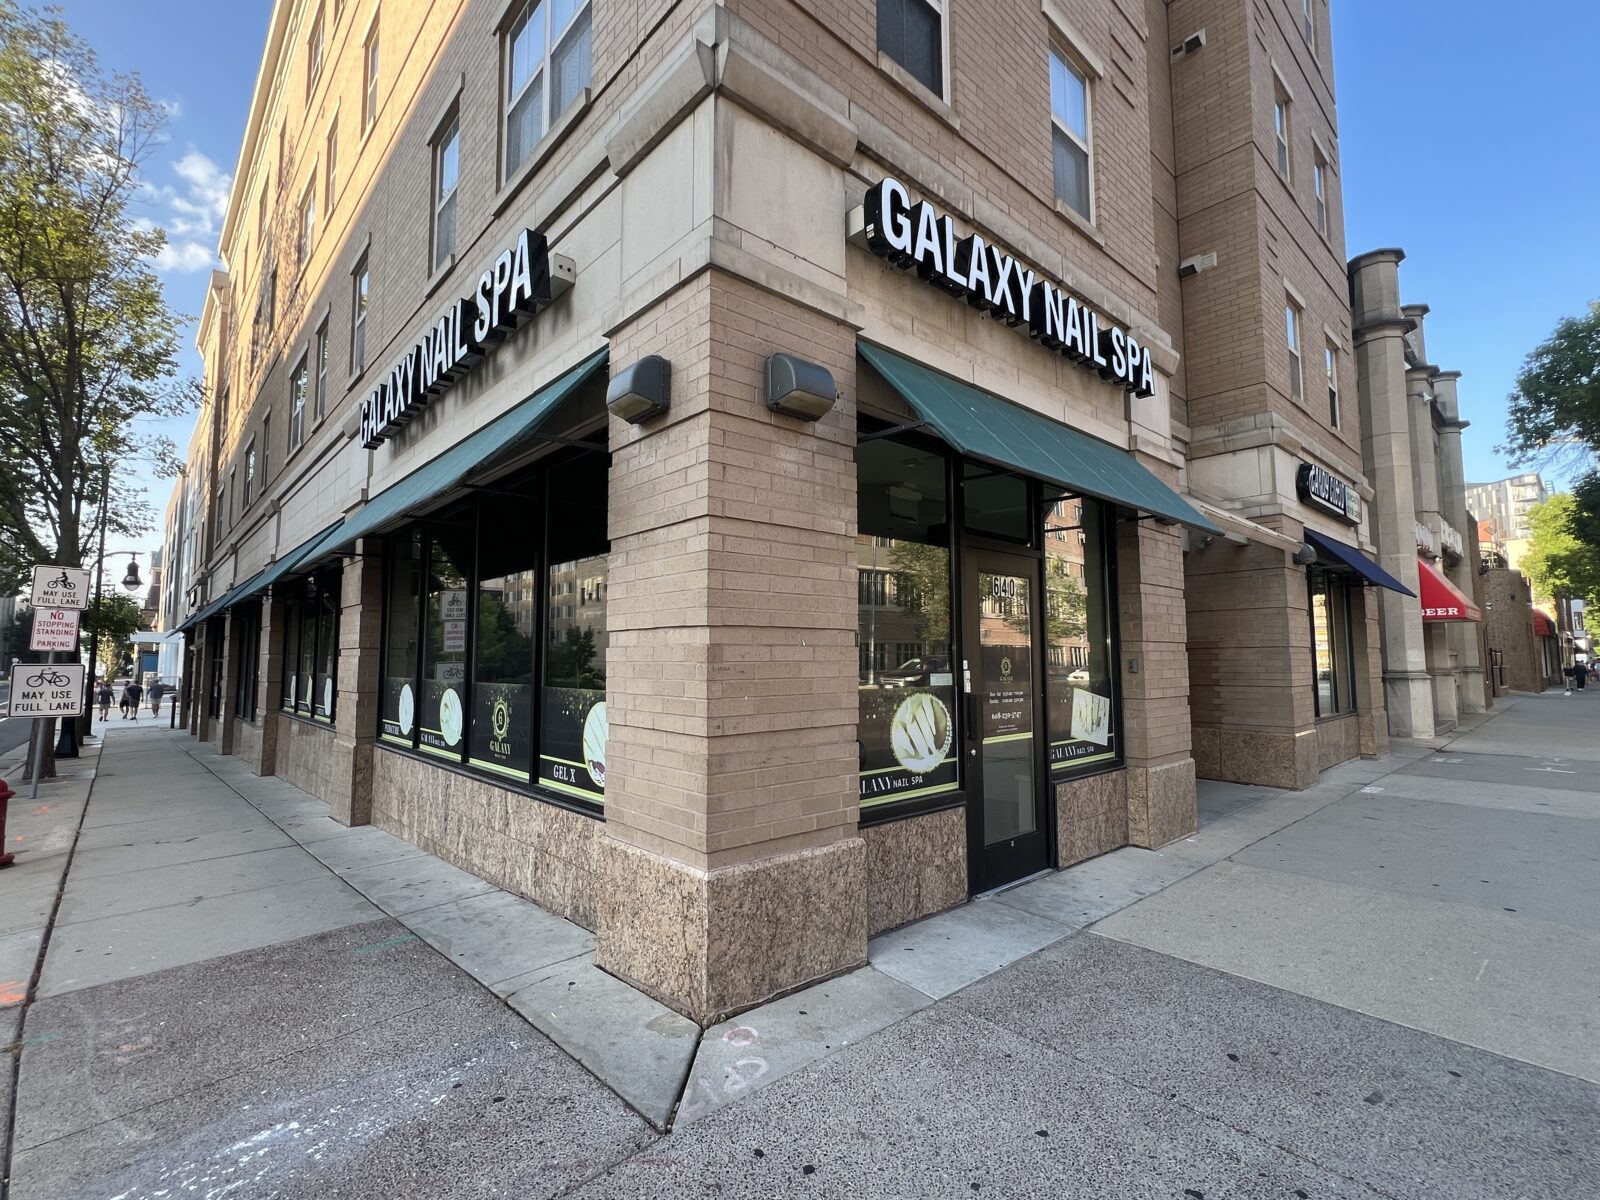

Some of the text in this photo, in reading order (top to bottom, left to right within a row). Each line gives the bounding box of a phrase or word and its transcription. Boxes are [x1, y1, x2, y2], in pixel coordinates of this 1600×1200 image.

[881, 177, 1155, 397] GALAXY NAIL SPA
[360, 228, 533, 449] GALAXY NAIL SPA
[993, 576, 1015, 597] 640
[60, 598, 81, 606] LANE
[50, 612, 64, 620] NO
[37, 620, 75, 628] STOPPING
[21, 690, 72, 700] MAY USE
[15, 702, 76, 712] FULL LANE
[489, 740, 512, 755] GALAXY
[553, 764, 576, 783] GEL X
[859, 775, 924, 795] LAXY NAIL SPA
